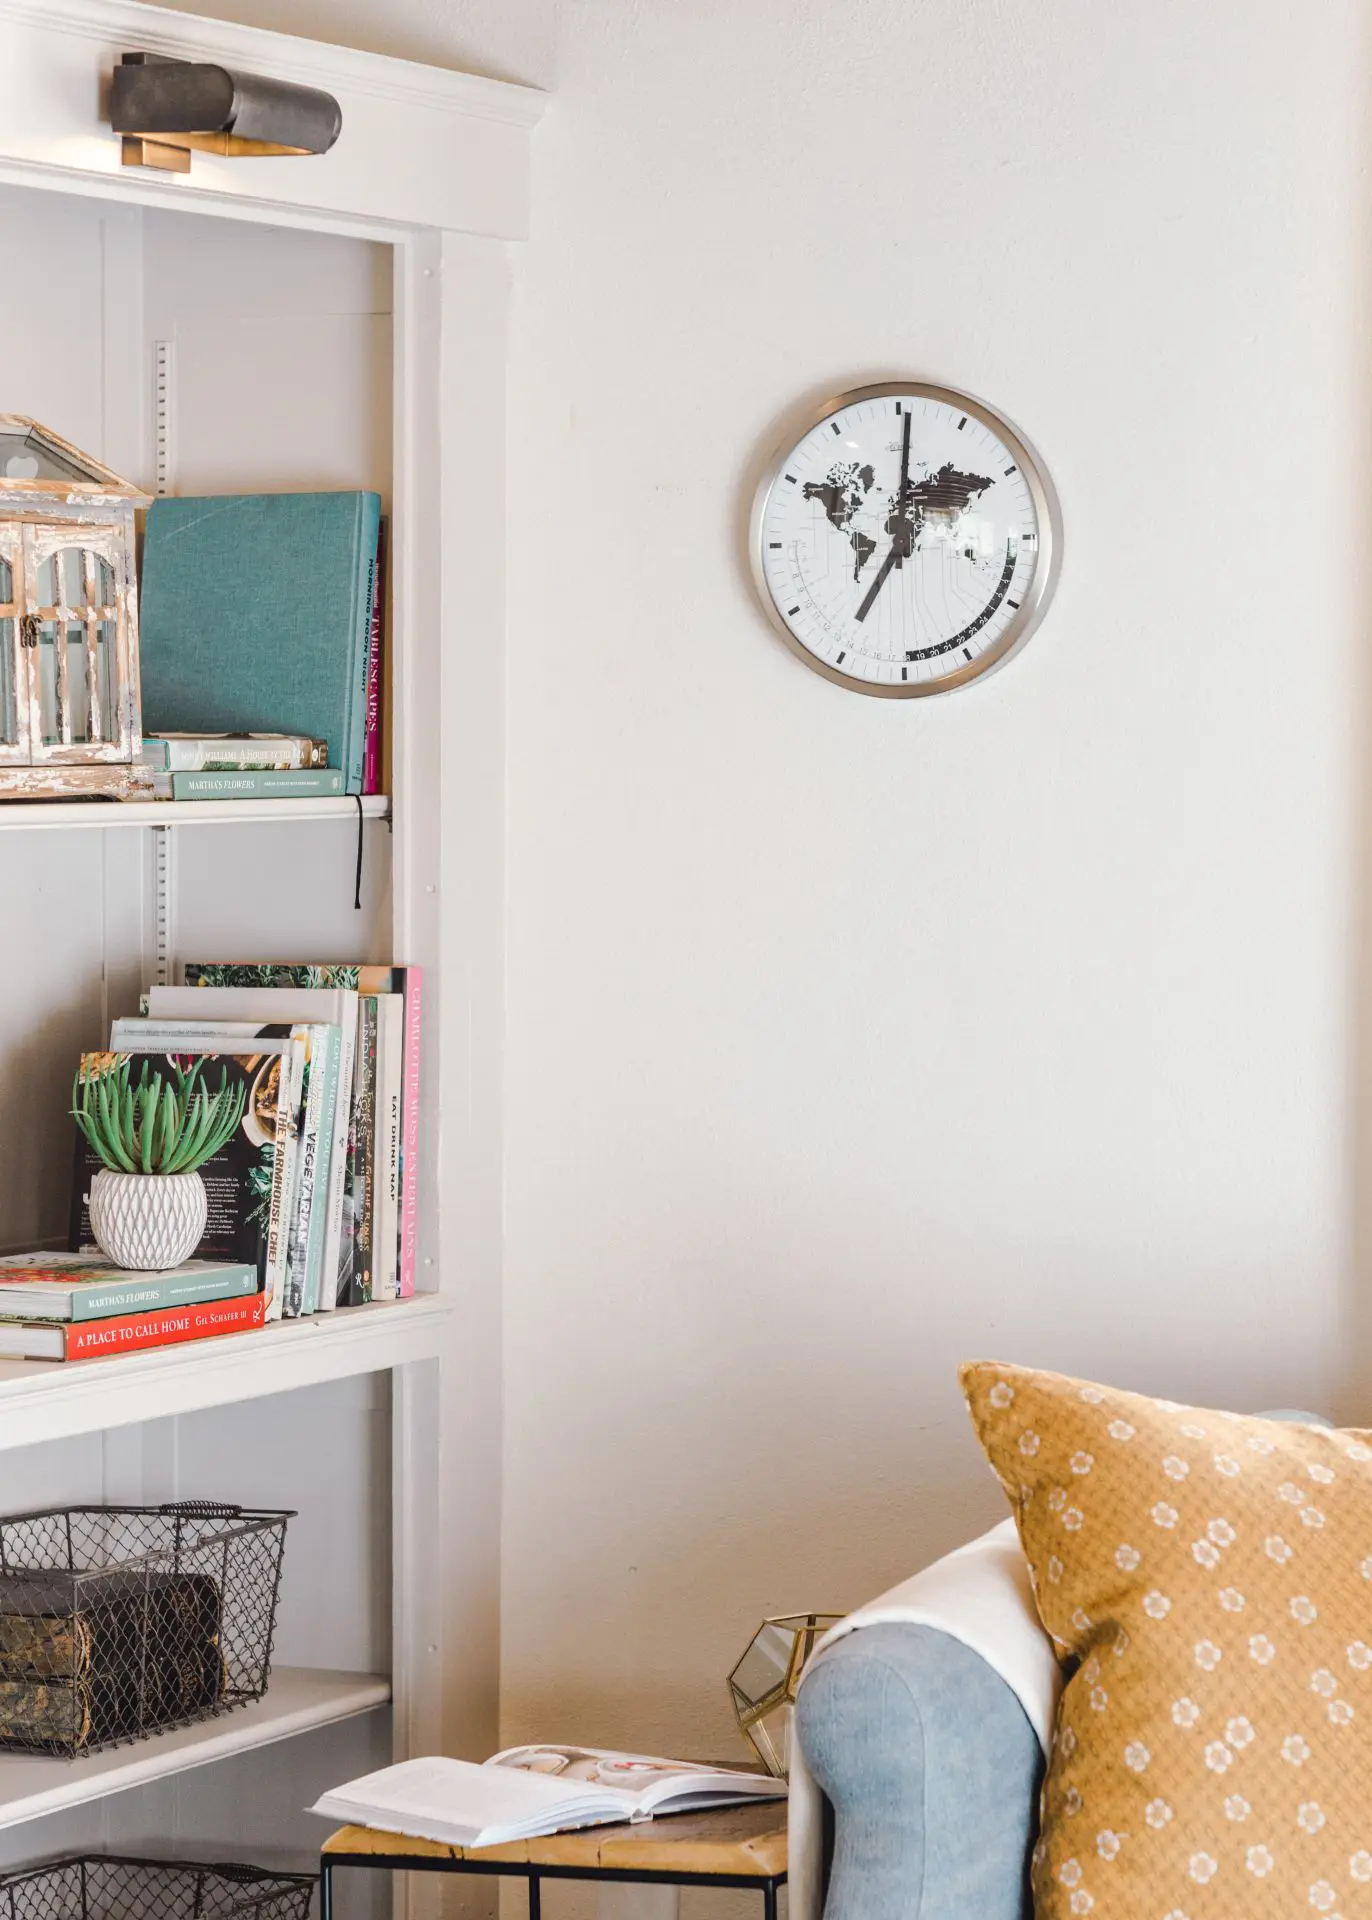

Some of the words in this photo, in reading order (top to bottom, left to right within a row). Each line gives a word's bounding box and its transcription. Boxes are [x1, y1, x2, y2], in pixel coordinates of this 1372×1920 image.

[366, 558, 374, 614] MORNING
[823, 622, 831, 631] 12
[846, 640, 854, 649] 14
[874, 651, 881, 660] 16
[916, 652, 926, 661] 19
[930, 649, 940, 658] 20
[943, 644, 953, 653] 21
[956, 636, 966, 646] 22
[968, 627, 978, 637] 23
[980, 616, 989, 626] 24
[360, 657, 368, 694] NIGHT
[368, 615, 380, 733] TABLESCAPES
[188, 780, 222, 790] MARTHA'S
[222, 780, 255, 790] FLOWERS
[332, 1037, 341, 1072] LOVE
[361, 1023, 369, 1071] INDIA
[410, 987, 421, 1092] CHARLOTTE
[278, 1110, 289, 1136] THE
[327, 1076, 337, 1126] WHERE
[360, 1081, 368, 1137] HICKS
[409, 1098, 418, 1146] MOSS
[324, 1130, 332, 1159] YOU
[270, 1140, 286, 1228] FARMHOUSE
[298, 1131, 317, 1245] VEGETARIAN
[320, 1163, 328, 1192] LIVE
[364, 1165, 372, 1251] GATHERINGS
[406, 1152, 417, 1259] ENTERTAINS
[268, 1231, 279, 1268] CHEF
[88, 1294, 125, 1309] MARTHA'S
[126, 1290, 160, 1304] FLOWERS
[77, 1336, 84, 1348] A
[86, 1330, 117, 1346] PLACE
[118, 1328, 134, 1340] TO
[135, 1324, 160, 1338] CALL
[161, 1318, 190, 1333] HOME
